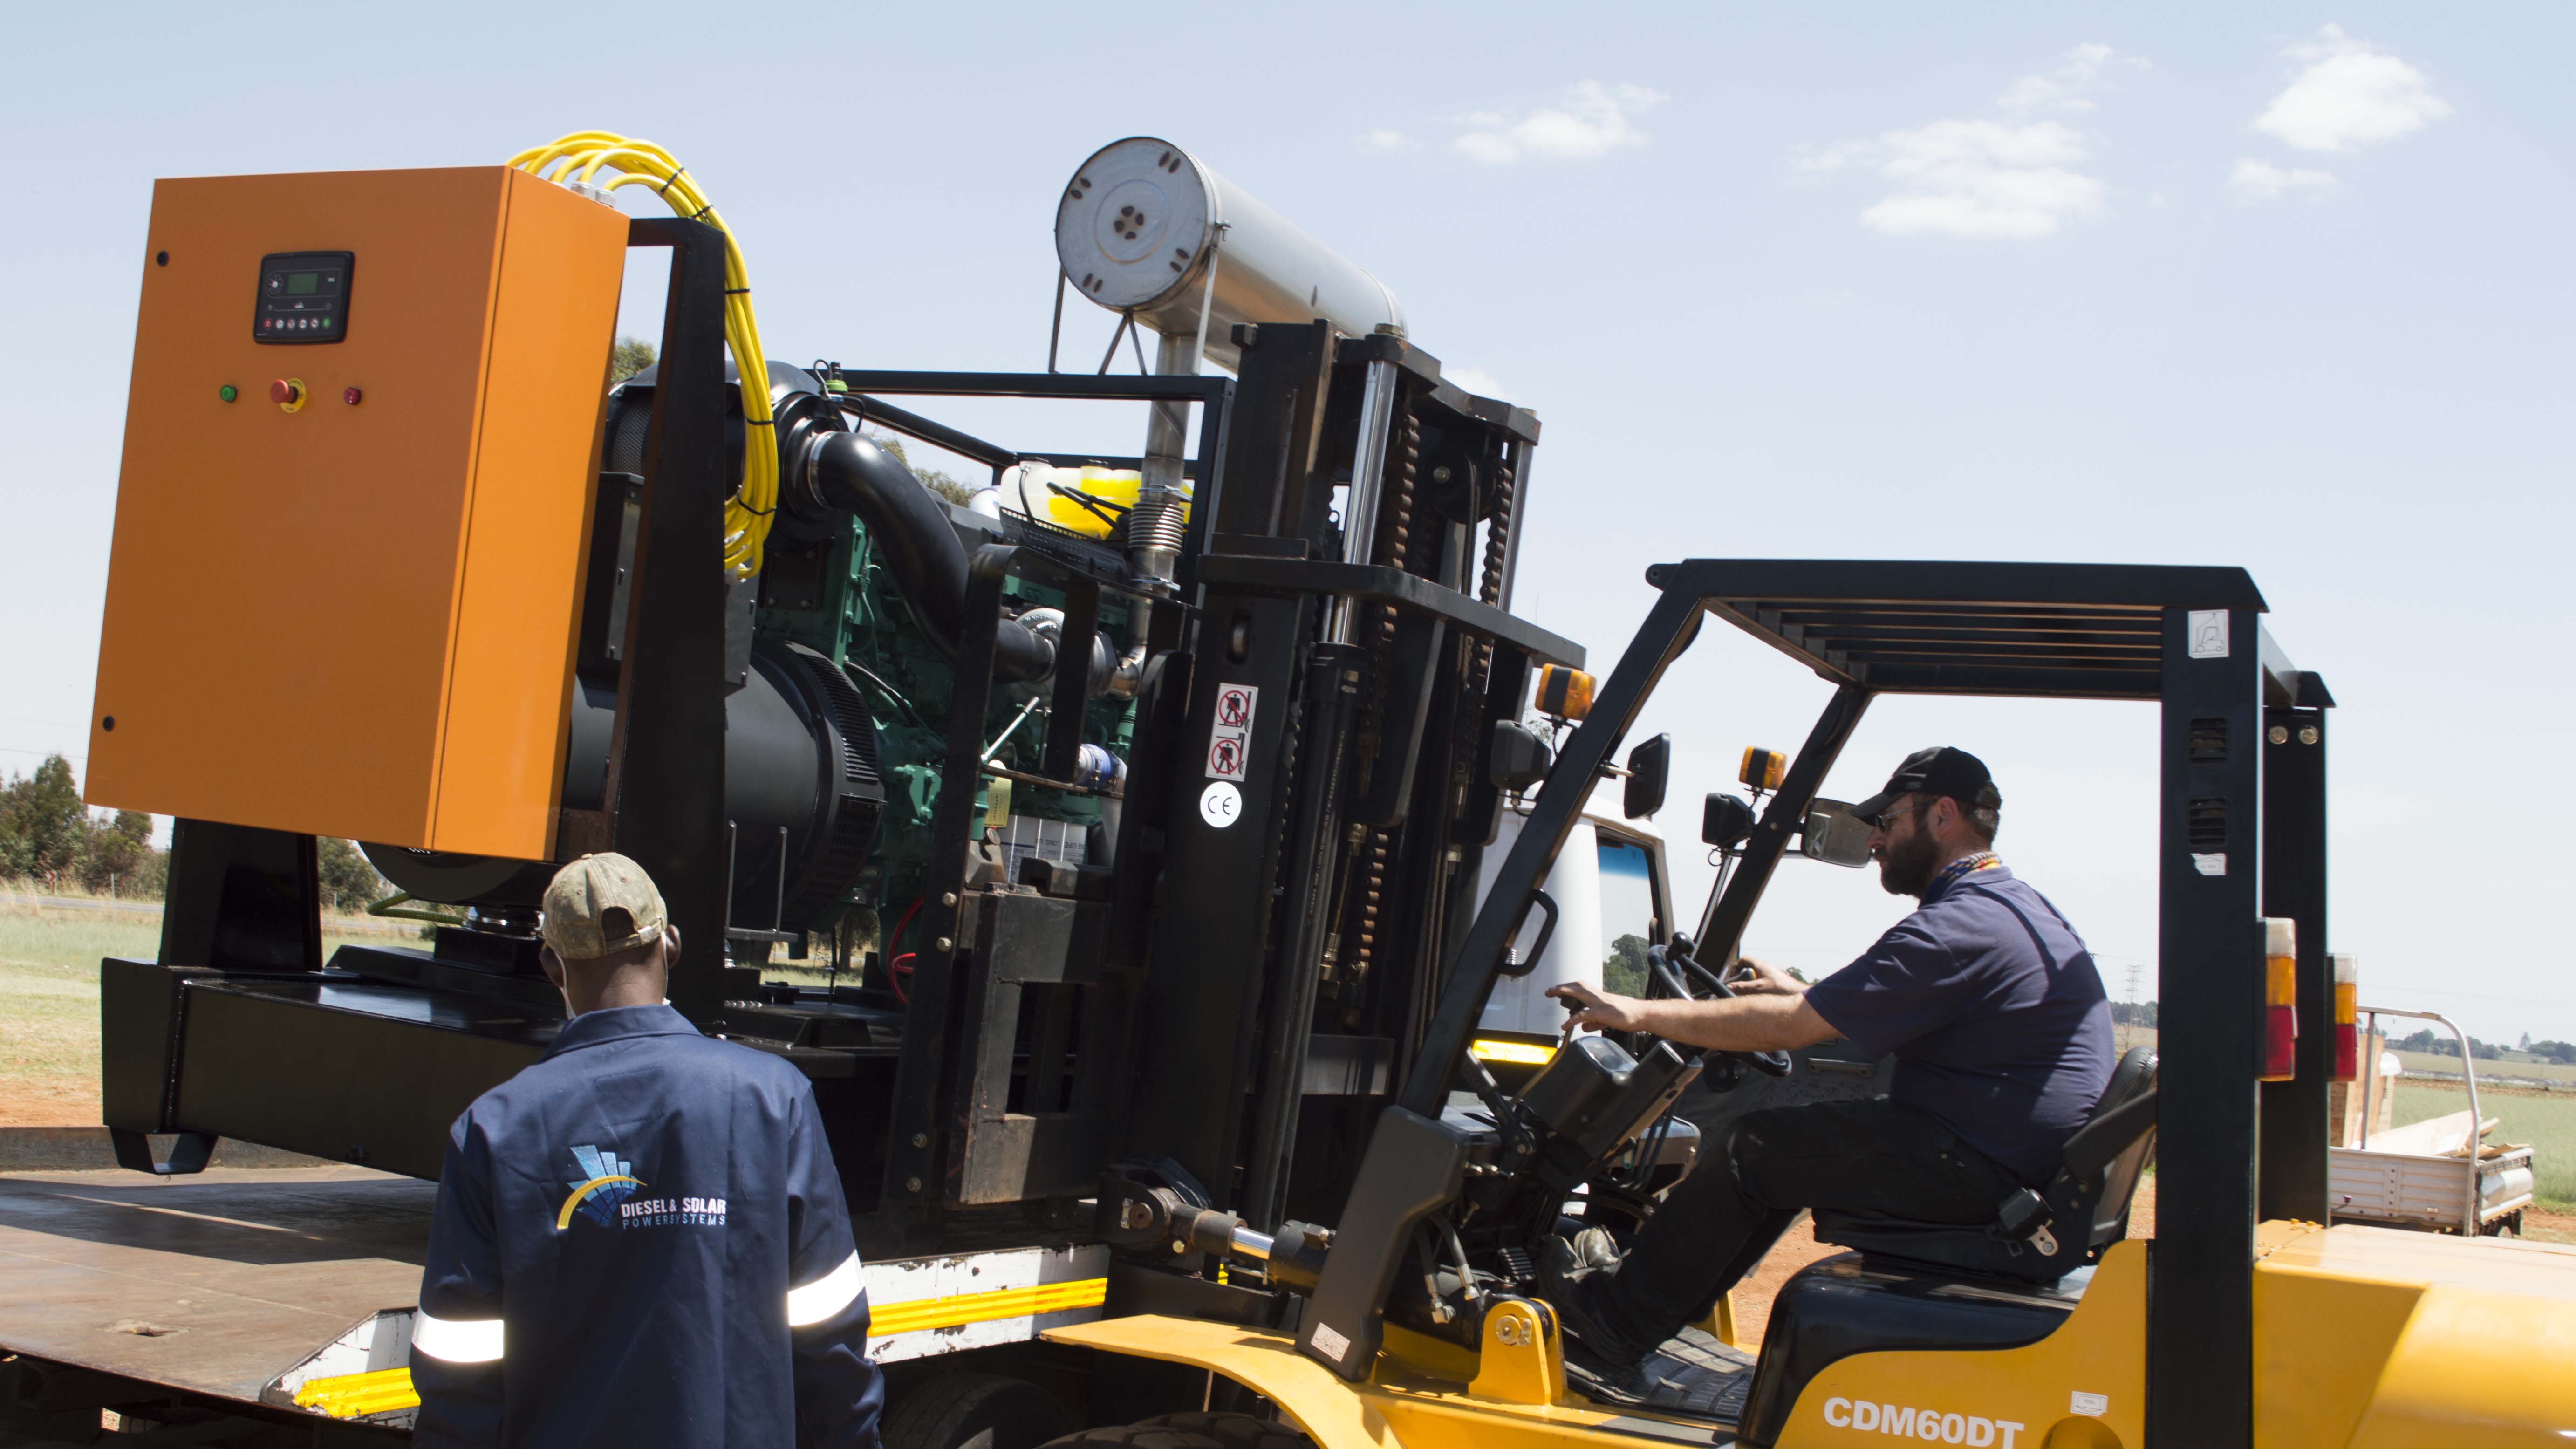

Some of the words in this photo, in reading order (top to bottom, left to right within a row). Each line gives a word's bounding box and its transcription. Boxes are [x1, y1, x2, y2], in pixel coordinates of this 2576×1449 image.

[1208, 795, 1232, 815] CE
[621, 1199, 667, 1217] DIESEL
[669, 1198, 677, 1212] &
[682, 1197, 726, 1215] SOLAR
[622, 1213, 726, 1230] POWERSYSTEMS
[1823, 1397, 2024, 1449] CDM60DT
